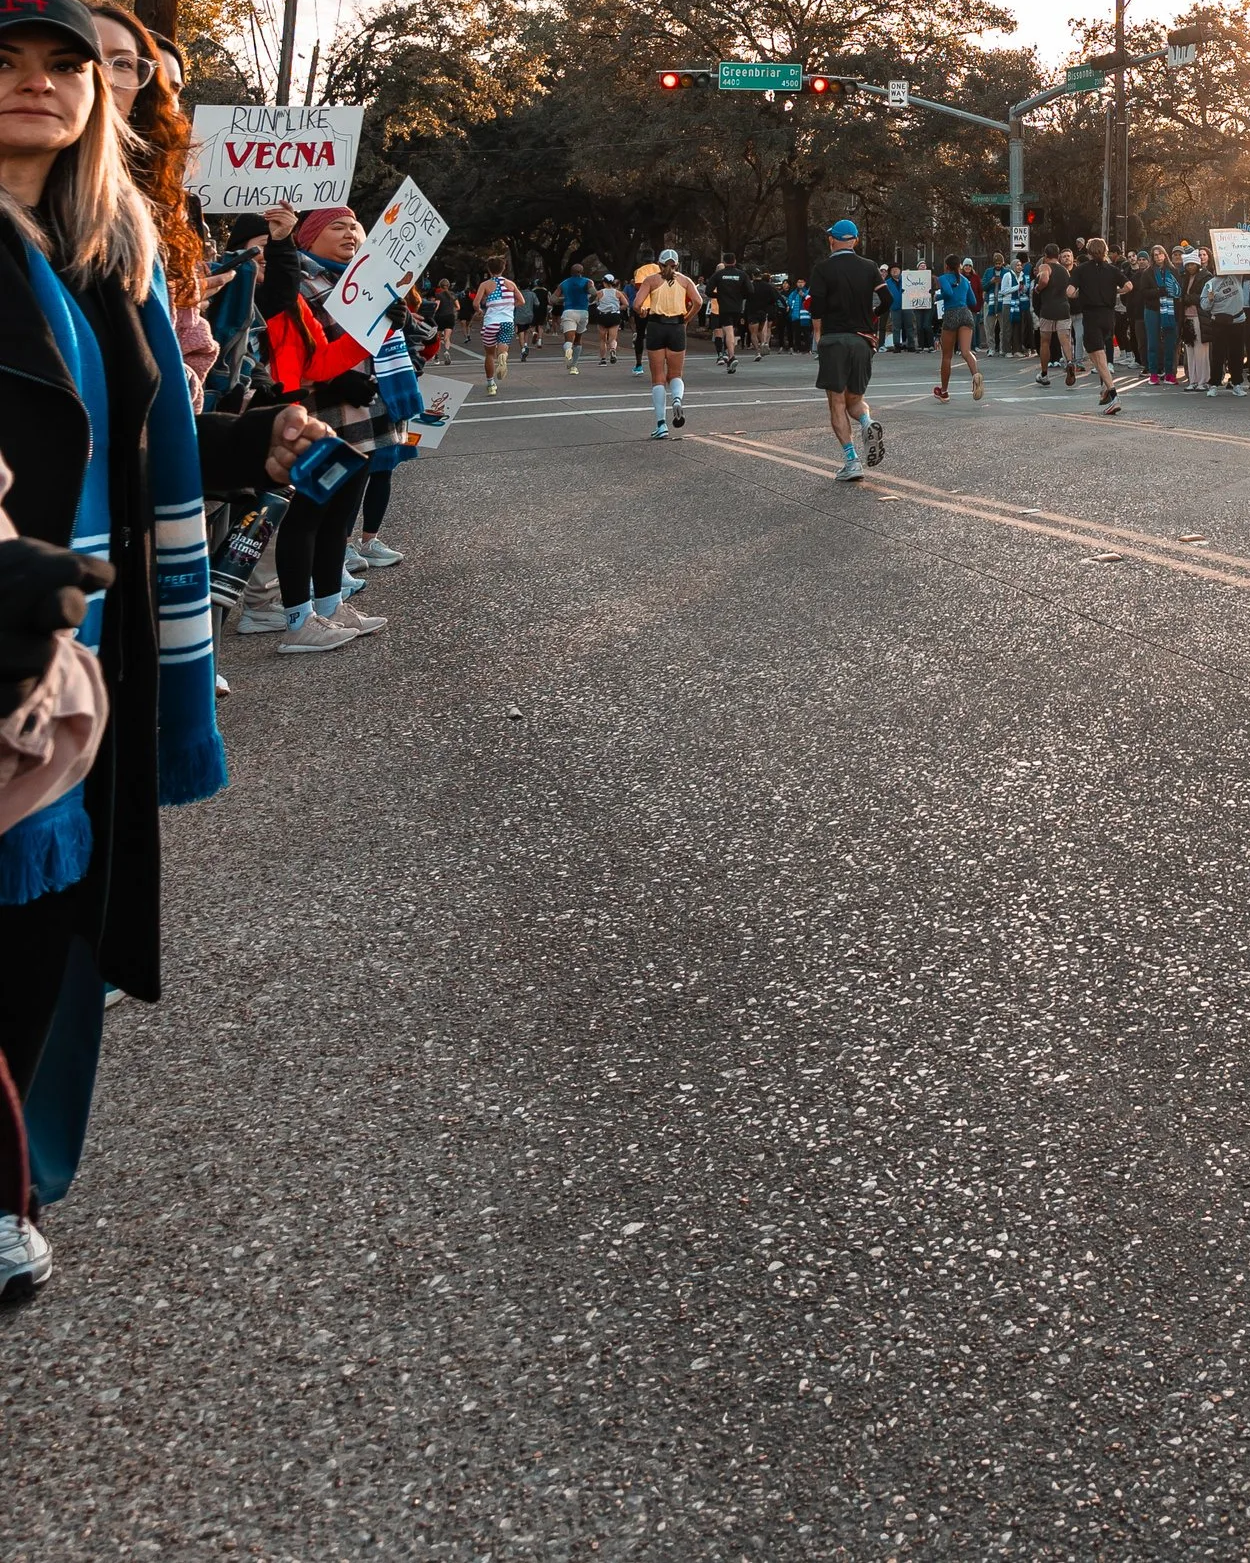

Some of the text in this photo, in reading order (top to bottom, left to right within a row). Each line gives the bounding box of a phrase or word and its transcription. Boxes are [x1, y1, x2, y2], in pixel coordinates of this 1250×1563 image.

[722, 66, 799, 78] Greenbriar Dr
[230, 106, 330, 134] RUN LIKE
[225, 141, 336, 169] VECNA
[223, 183, 303, 207] CHASING
[314, 180, 346, 203] YOU
[400, 221, 417, 242] @
[378, 228, 417, 272] MILE
[341, 253, 371, 305] 6
[228, 532, 263, 550] planet
[229, 540, 263, 560] fitness
